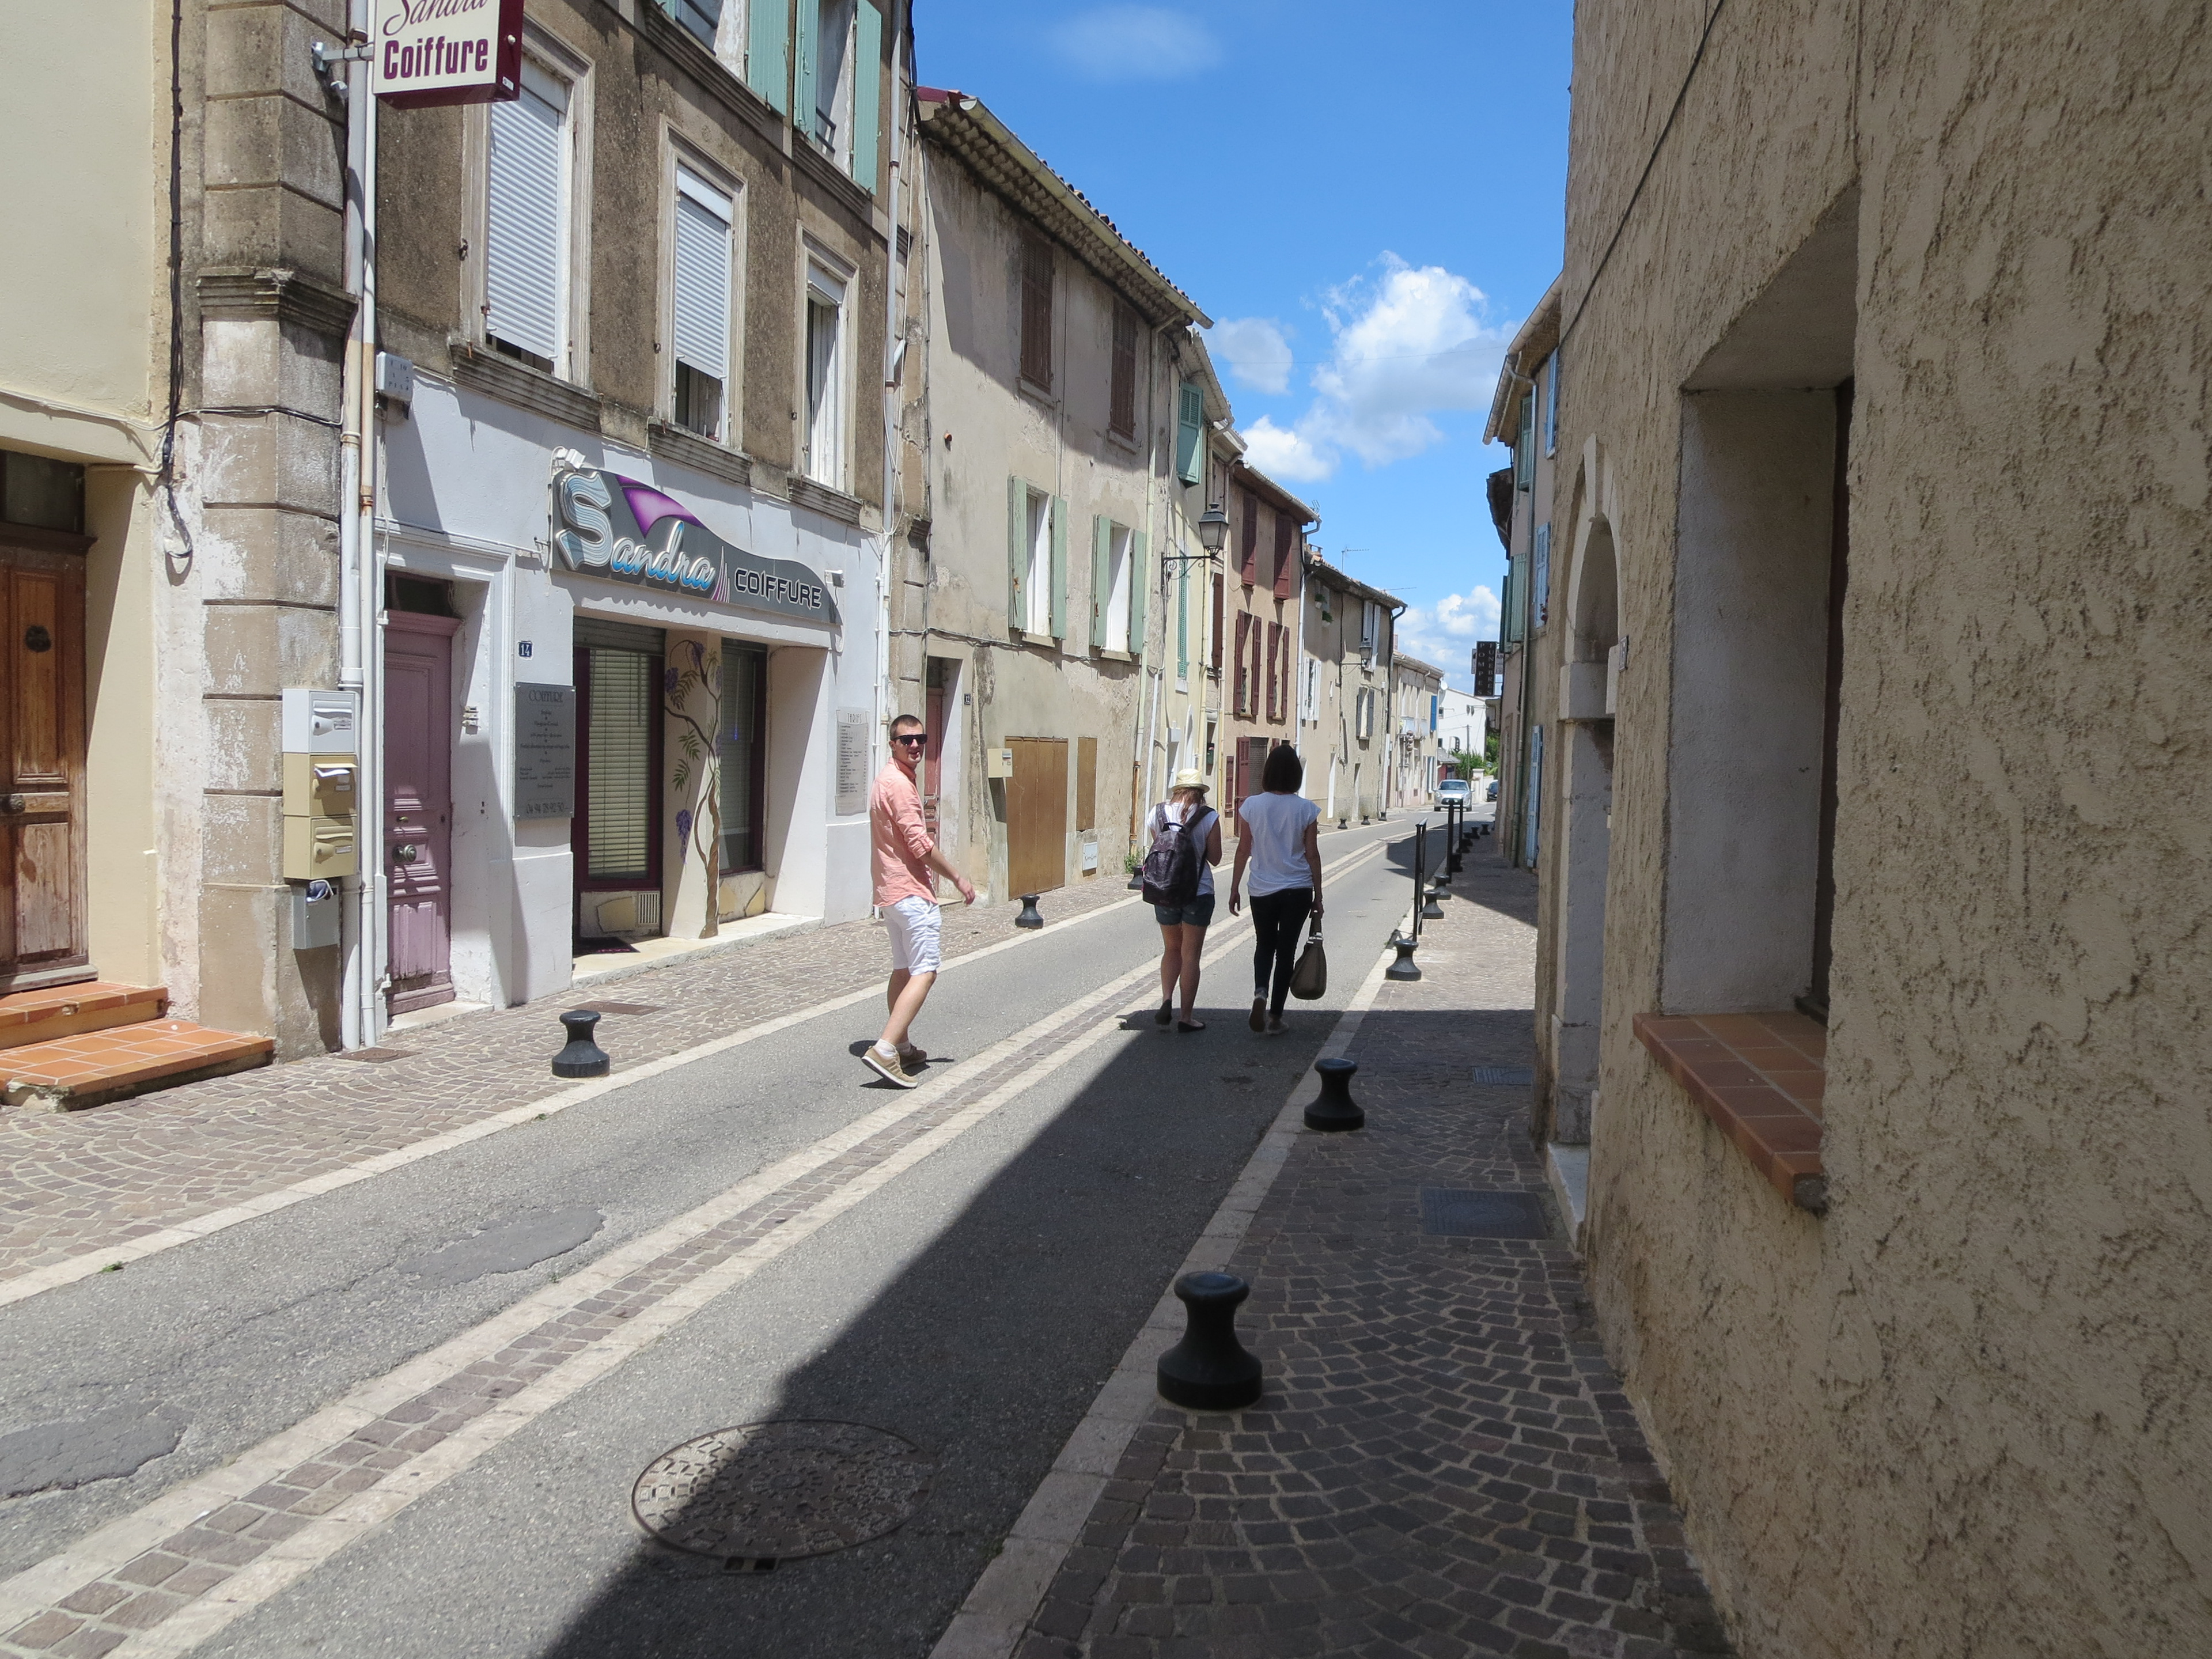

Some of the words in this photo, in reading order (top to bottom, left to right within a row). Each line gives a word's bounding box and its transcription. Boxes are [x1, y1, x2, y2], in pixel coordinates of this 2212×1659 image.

[382, 0, 488, 36] San
[384, 36, 488, 79] Coiffure
[555, 471, 716, 591] Sandra
[734, 567, 822, 609] COIFFURE
[520, 643, 531, 657] 14
[1478, 643, 1486, 695] POMPES
[847, 713, 862, 724] TARIFS
